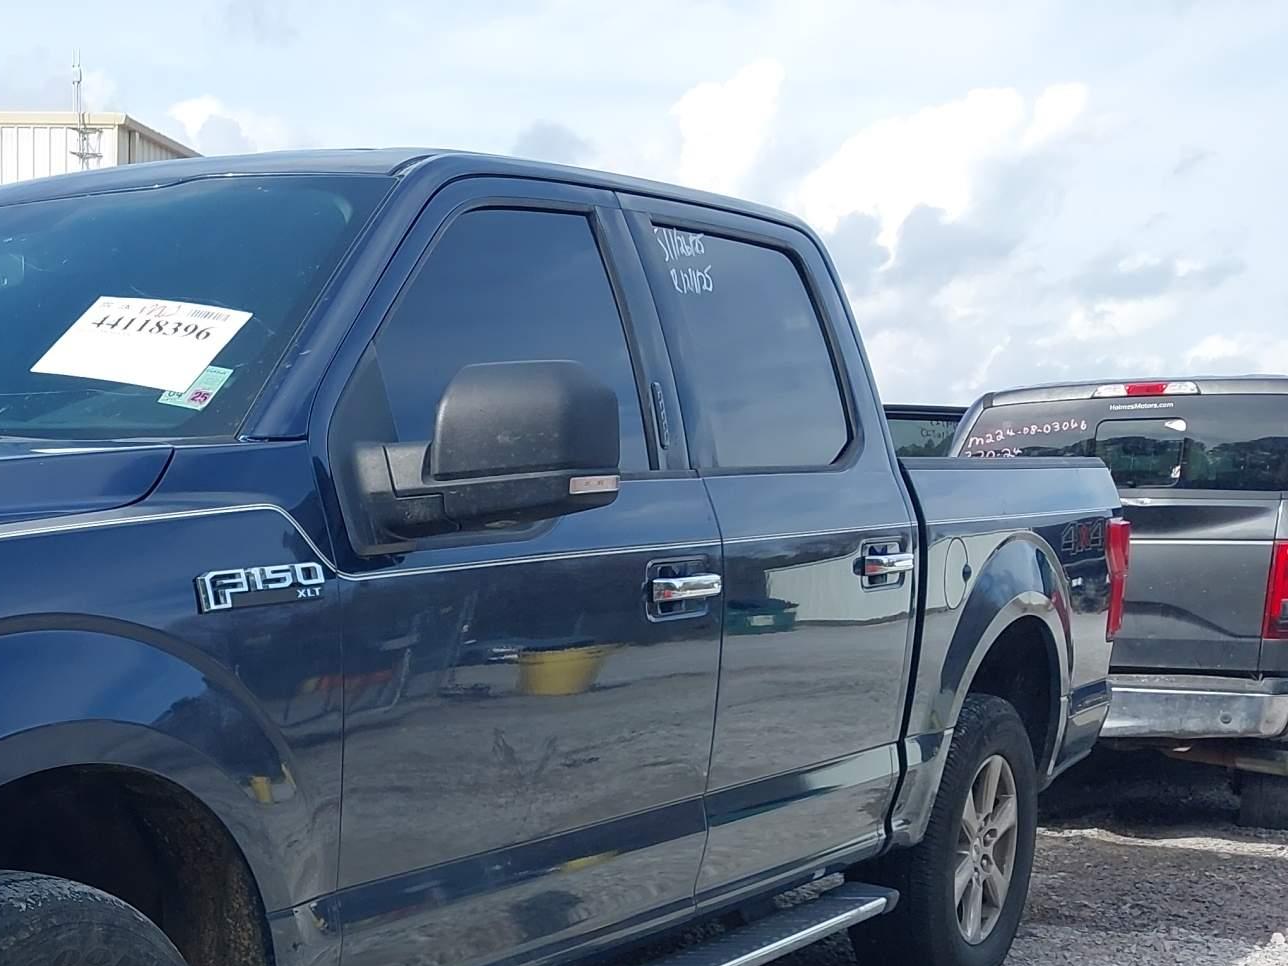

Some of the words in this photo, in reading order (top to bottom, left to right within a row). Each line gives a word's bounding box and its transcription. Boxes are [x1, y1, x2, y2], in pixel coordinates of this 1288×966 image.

[91, 313, 215, 341] 44118396
[190, 391, 209, 402] 25
[297, 586, 322, 598] XLT
